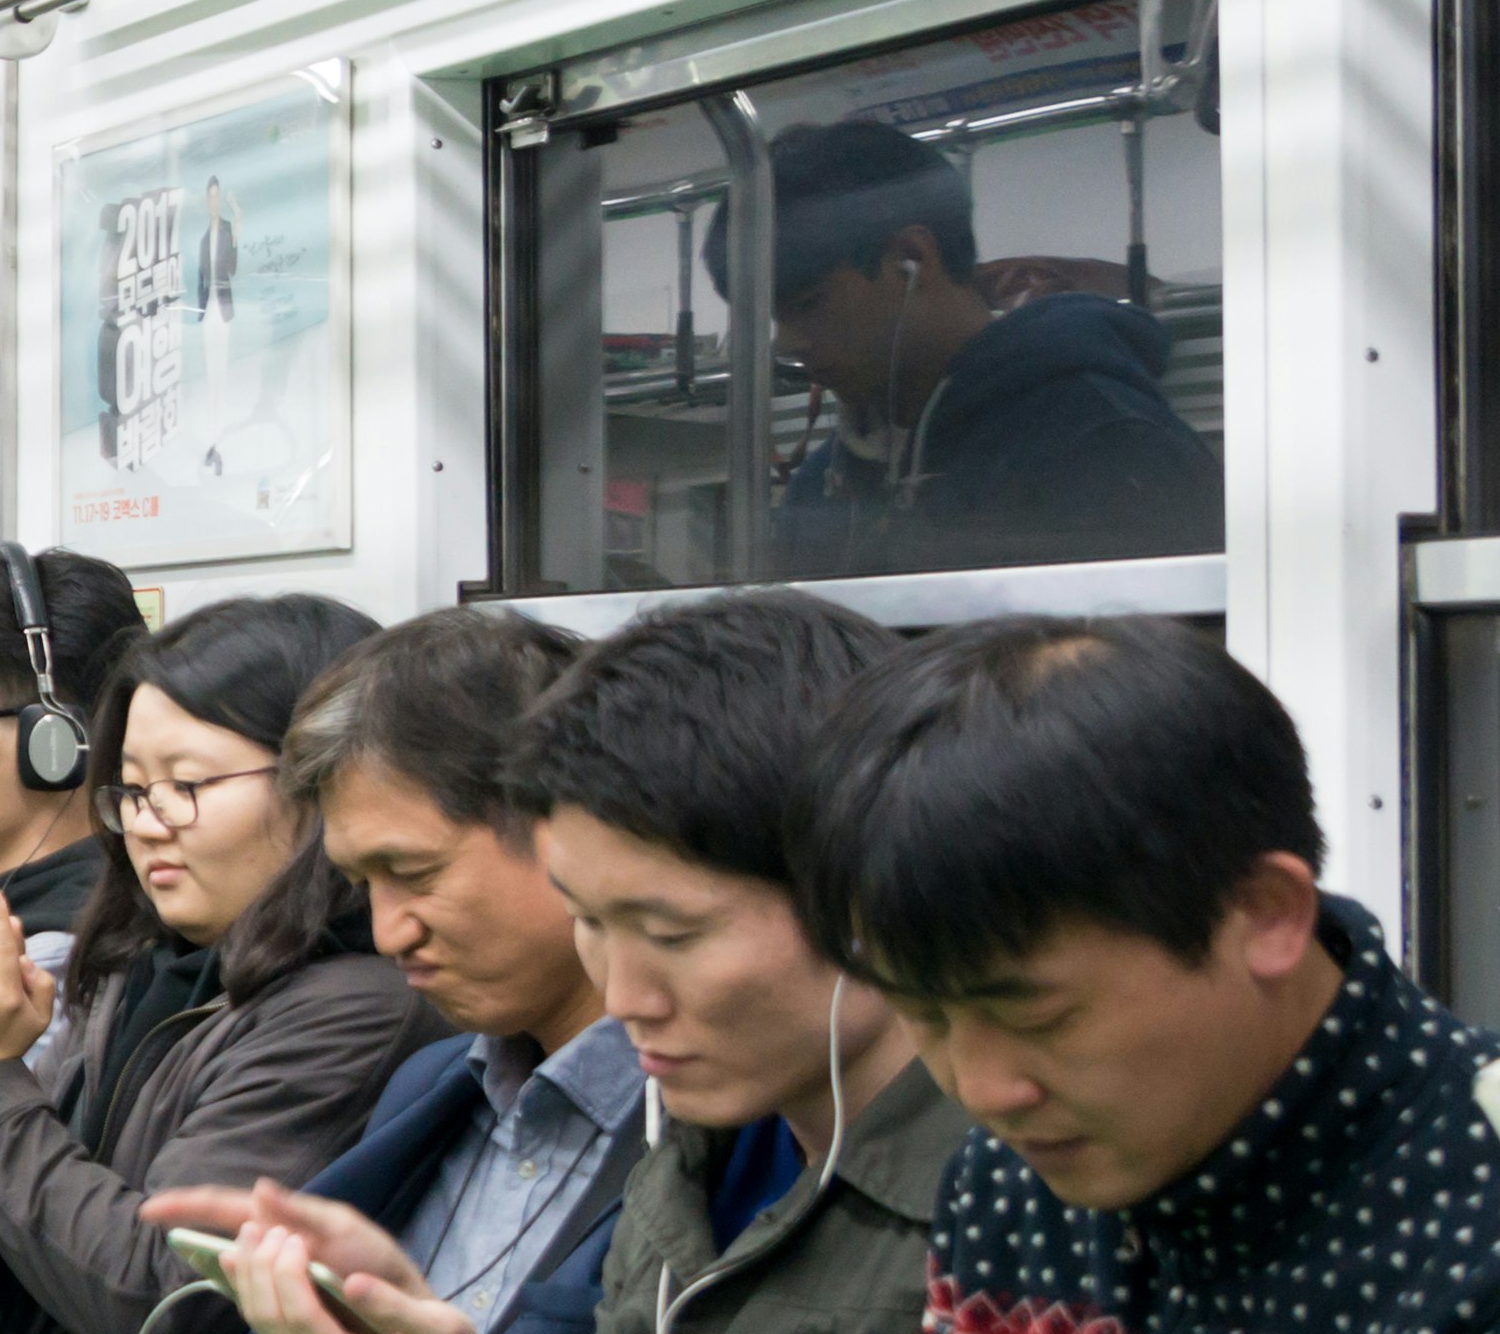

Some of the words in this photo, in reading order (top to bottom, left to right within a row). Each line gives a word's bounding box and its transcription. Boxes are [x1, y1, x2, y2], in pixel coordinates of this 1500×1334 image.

[116, 187, 185, 280] 2017
[116, 320, 182, 416] 여행
[116, 385, 180, 472] 박람회
